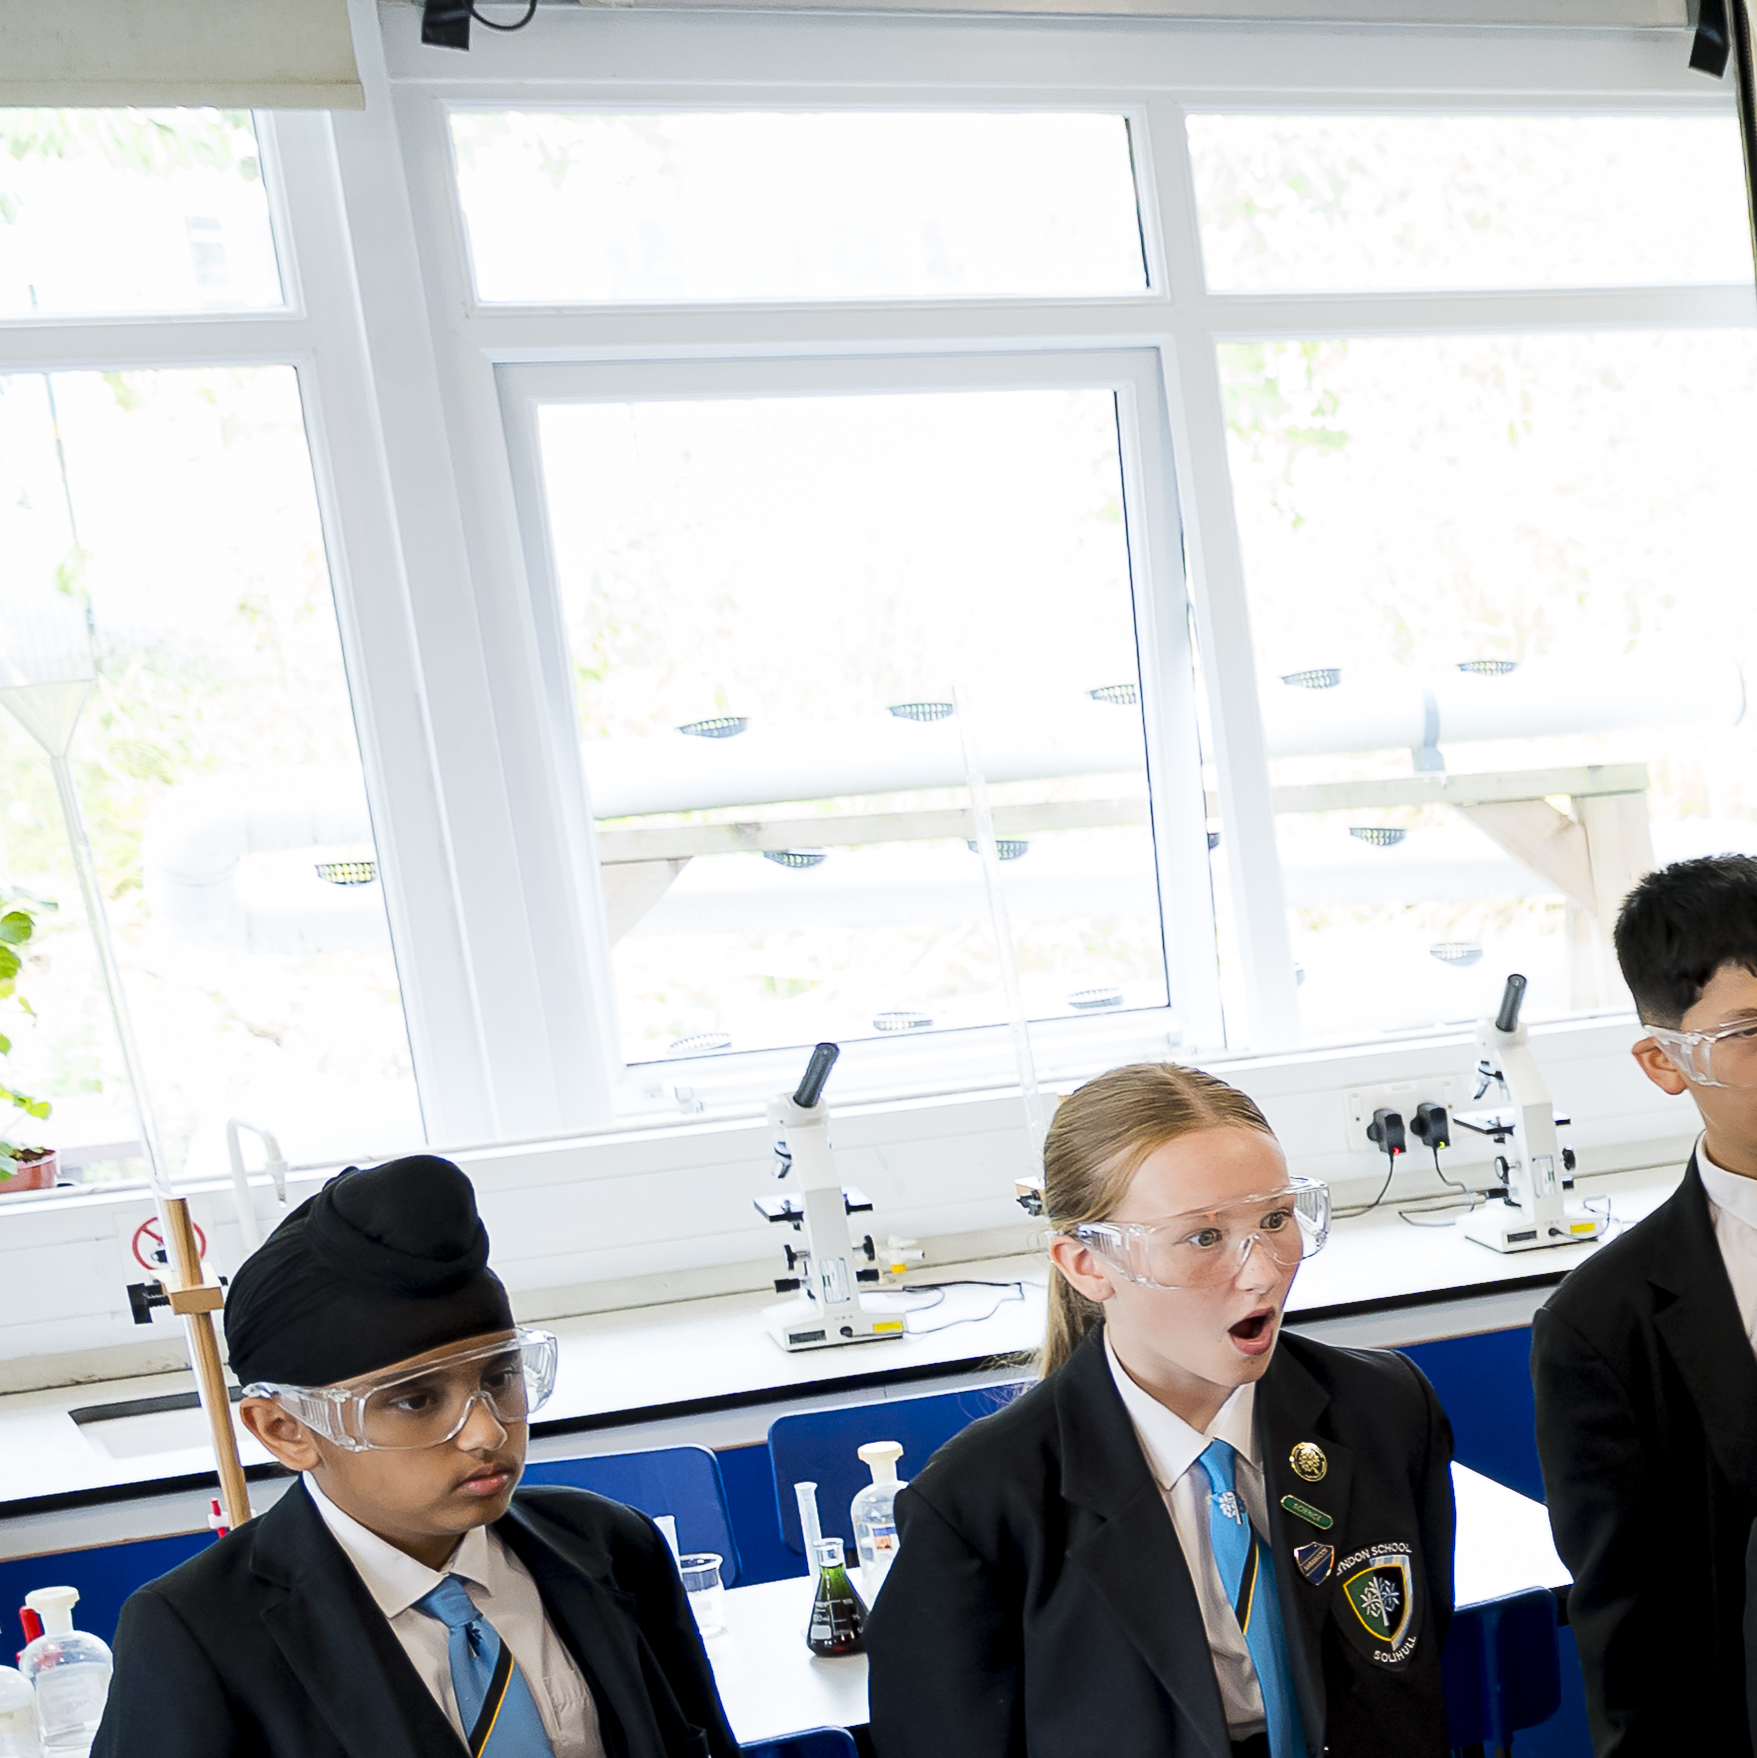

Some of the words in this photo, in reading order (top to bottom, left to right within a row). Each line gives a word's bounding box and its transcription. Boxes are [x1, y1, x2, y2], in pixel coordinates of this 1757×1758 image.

[1292, 1502, 1322, 1522] SCIENCE
[1371, 1542, 1412, 1556] SCHOOL
[1374, 1635, 1417, 1663] SOLIHULL
